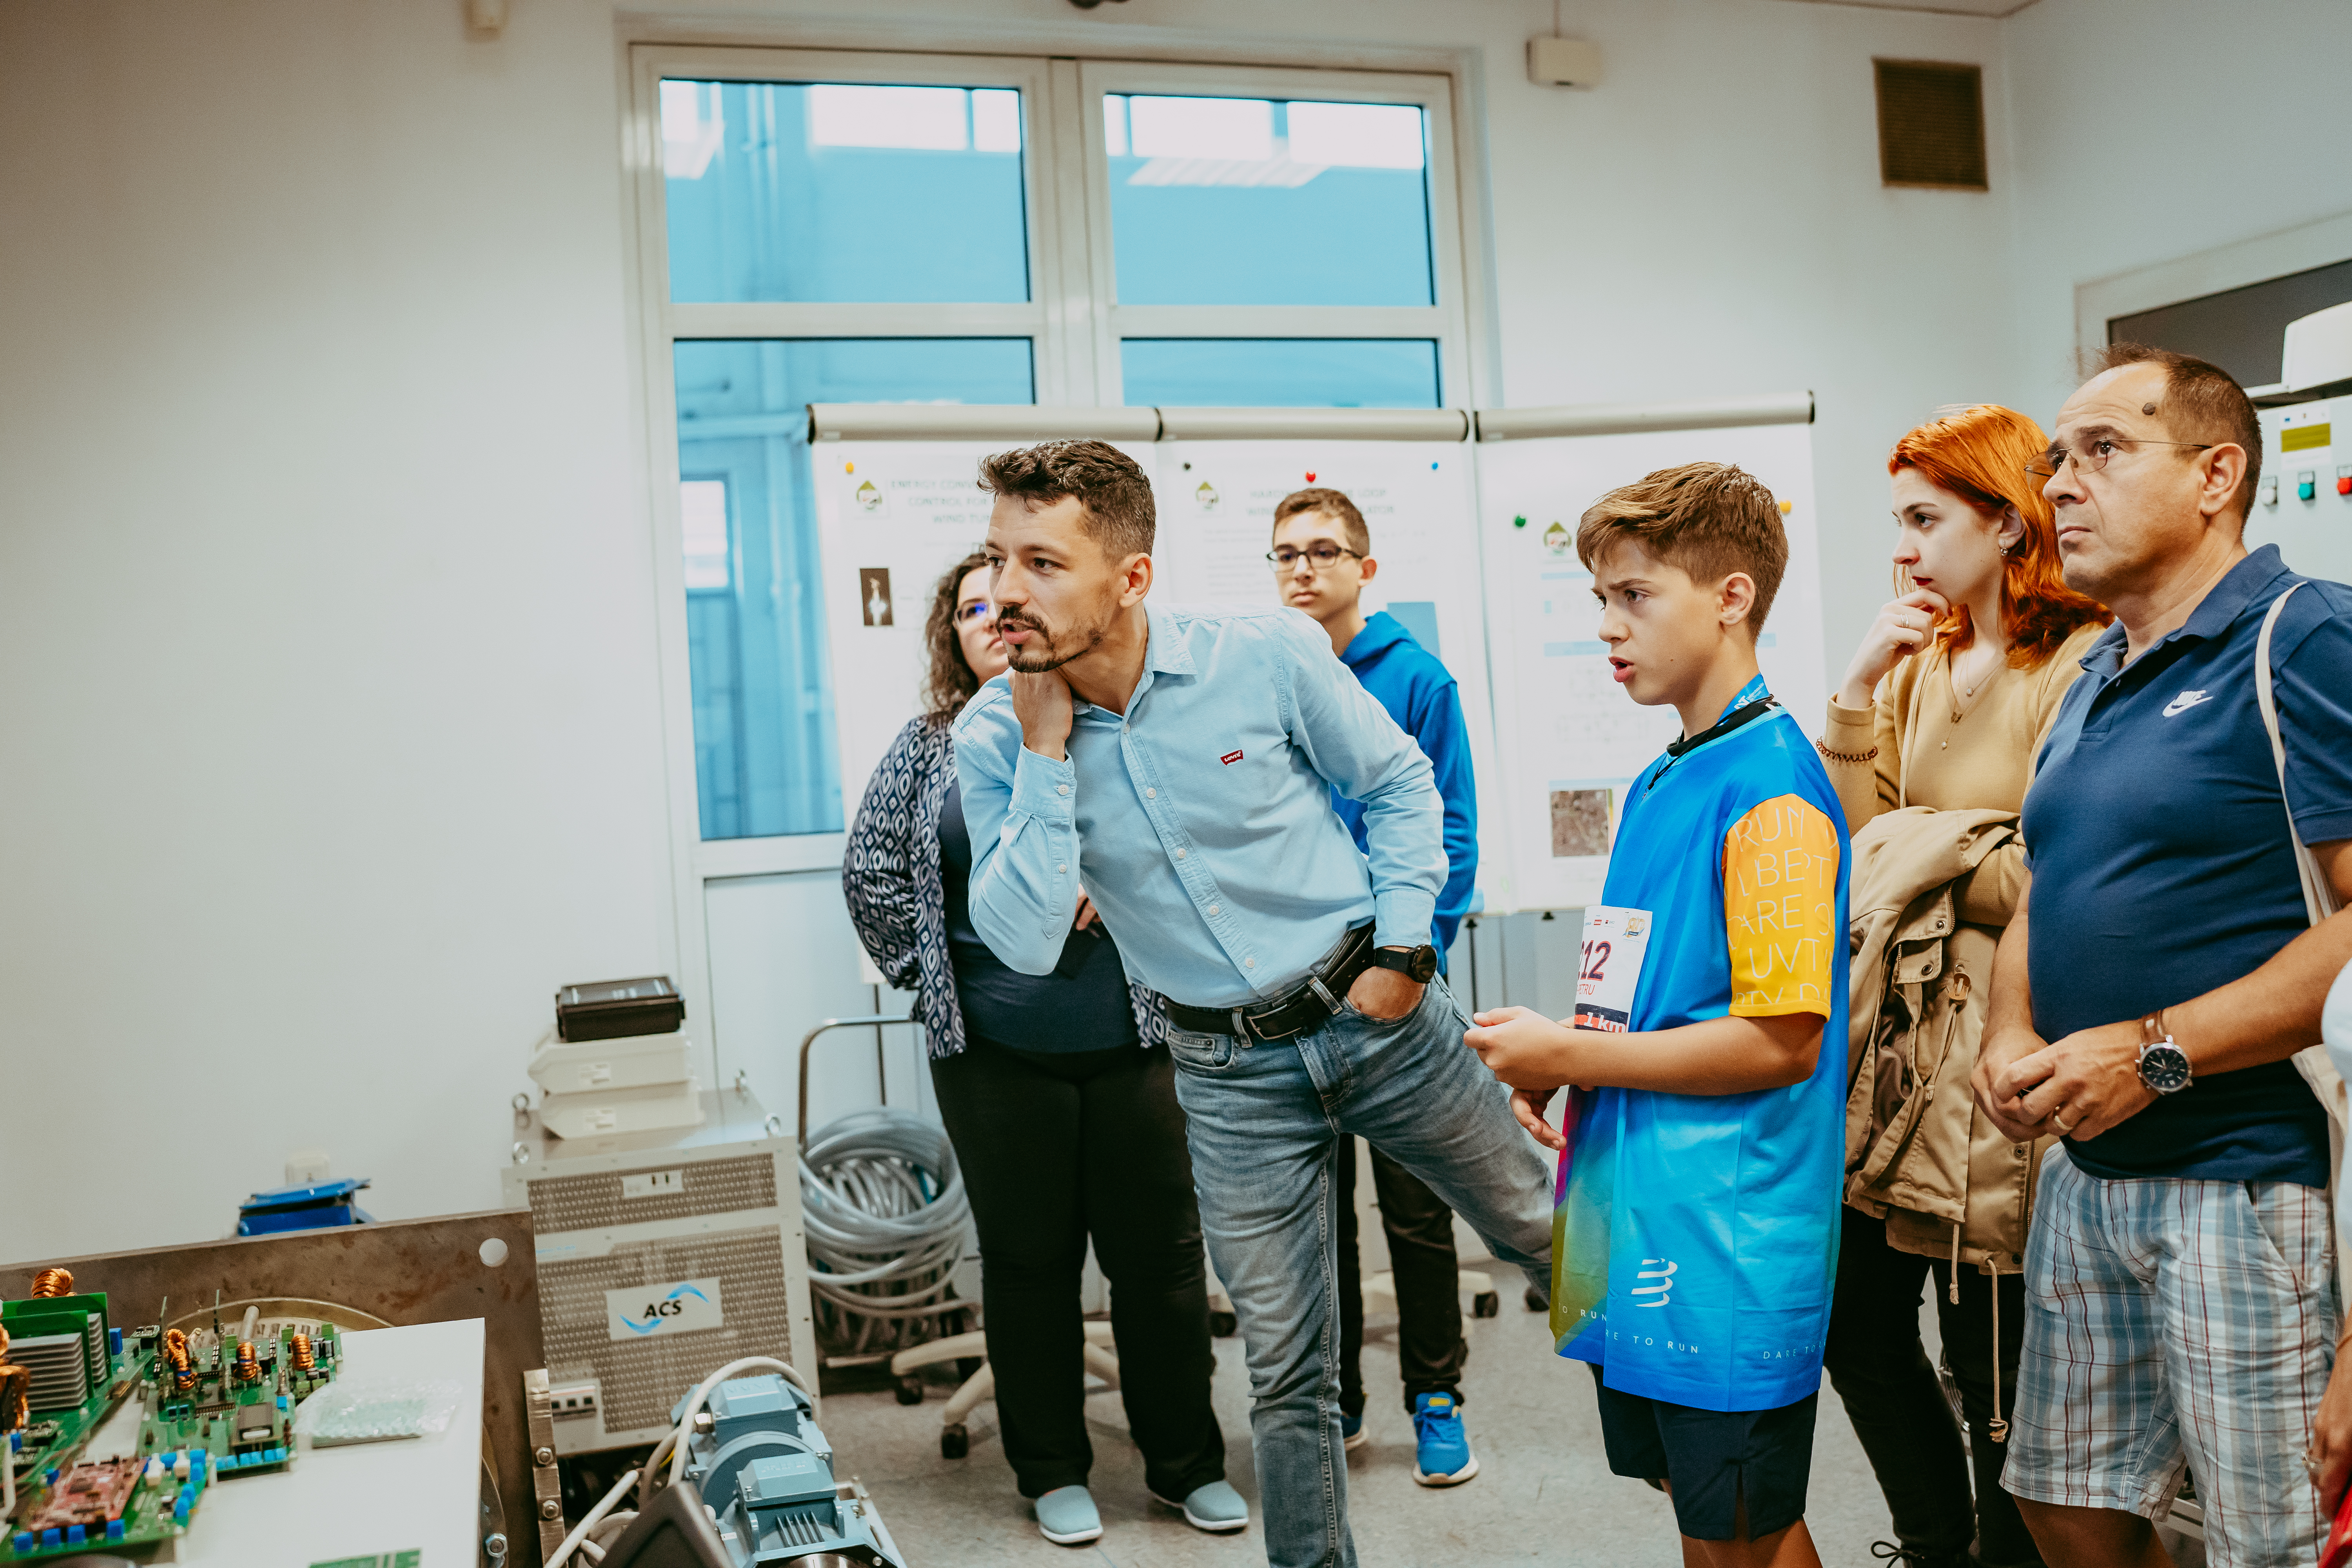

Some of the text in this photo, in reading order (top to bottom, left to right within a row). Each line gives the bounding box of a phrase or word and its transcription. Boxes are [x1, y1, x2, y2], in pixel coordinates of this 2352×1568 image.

[908, 497, 962, 507] CONTROL
[1733, 806, 1804, 852] RUN
[1578, 940, 1612, 982] 12
[1749, 937, 1820, 979] UVT
[1584, 1011, 1626, 1033] 1 km
[643, 1299, 682, 1319] ACS
[1580, 1309, 1607, 1322] RUN
[1633, 1336, 1653, 1346] TO
[1668, 1341, 1698, 1354] RUN
[1763, 1348, 1797, 1359] DARE
